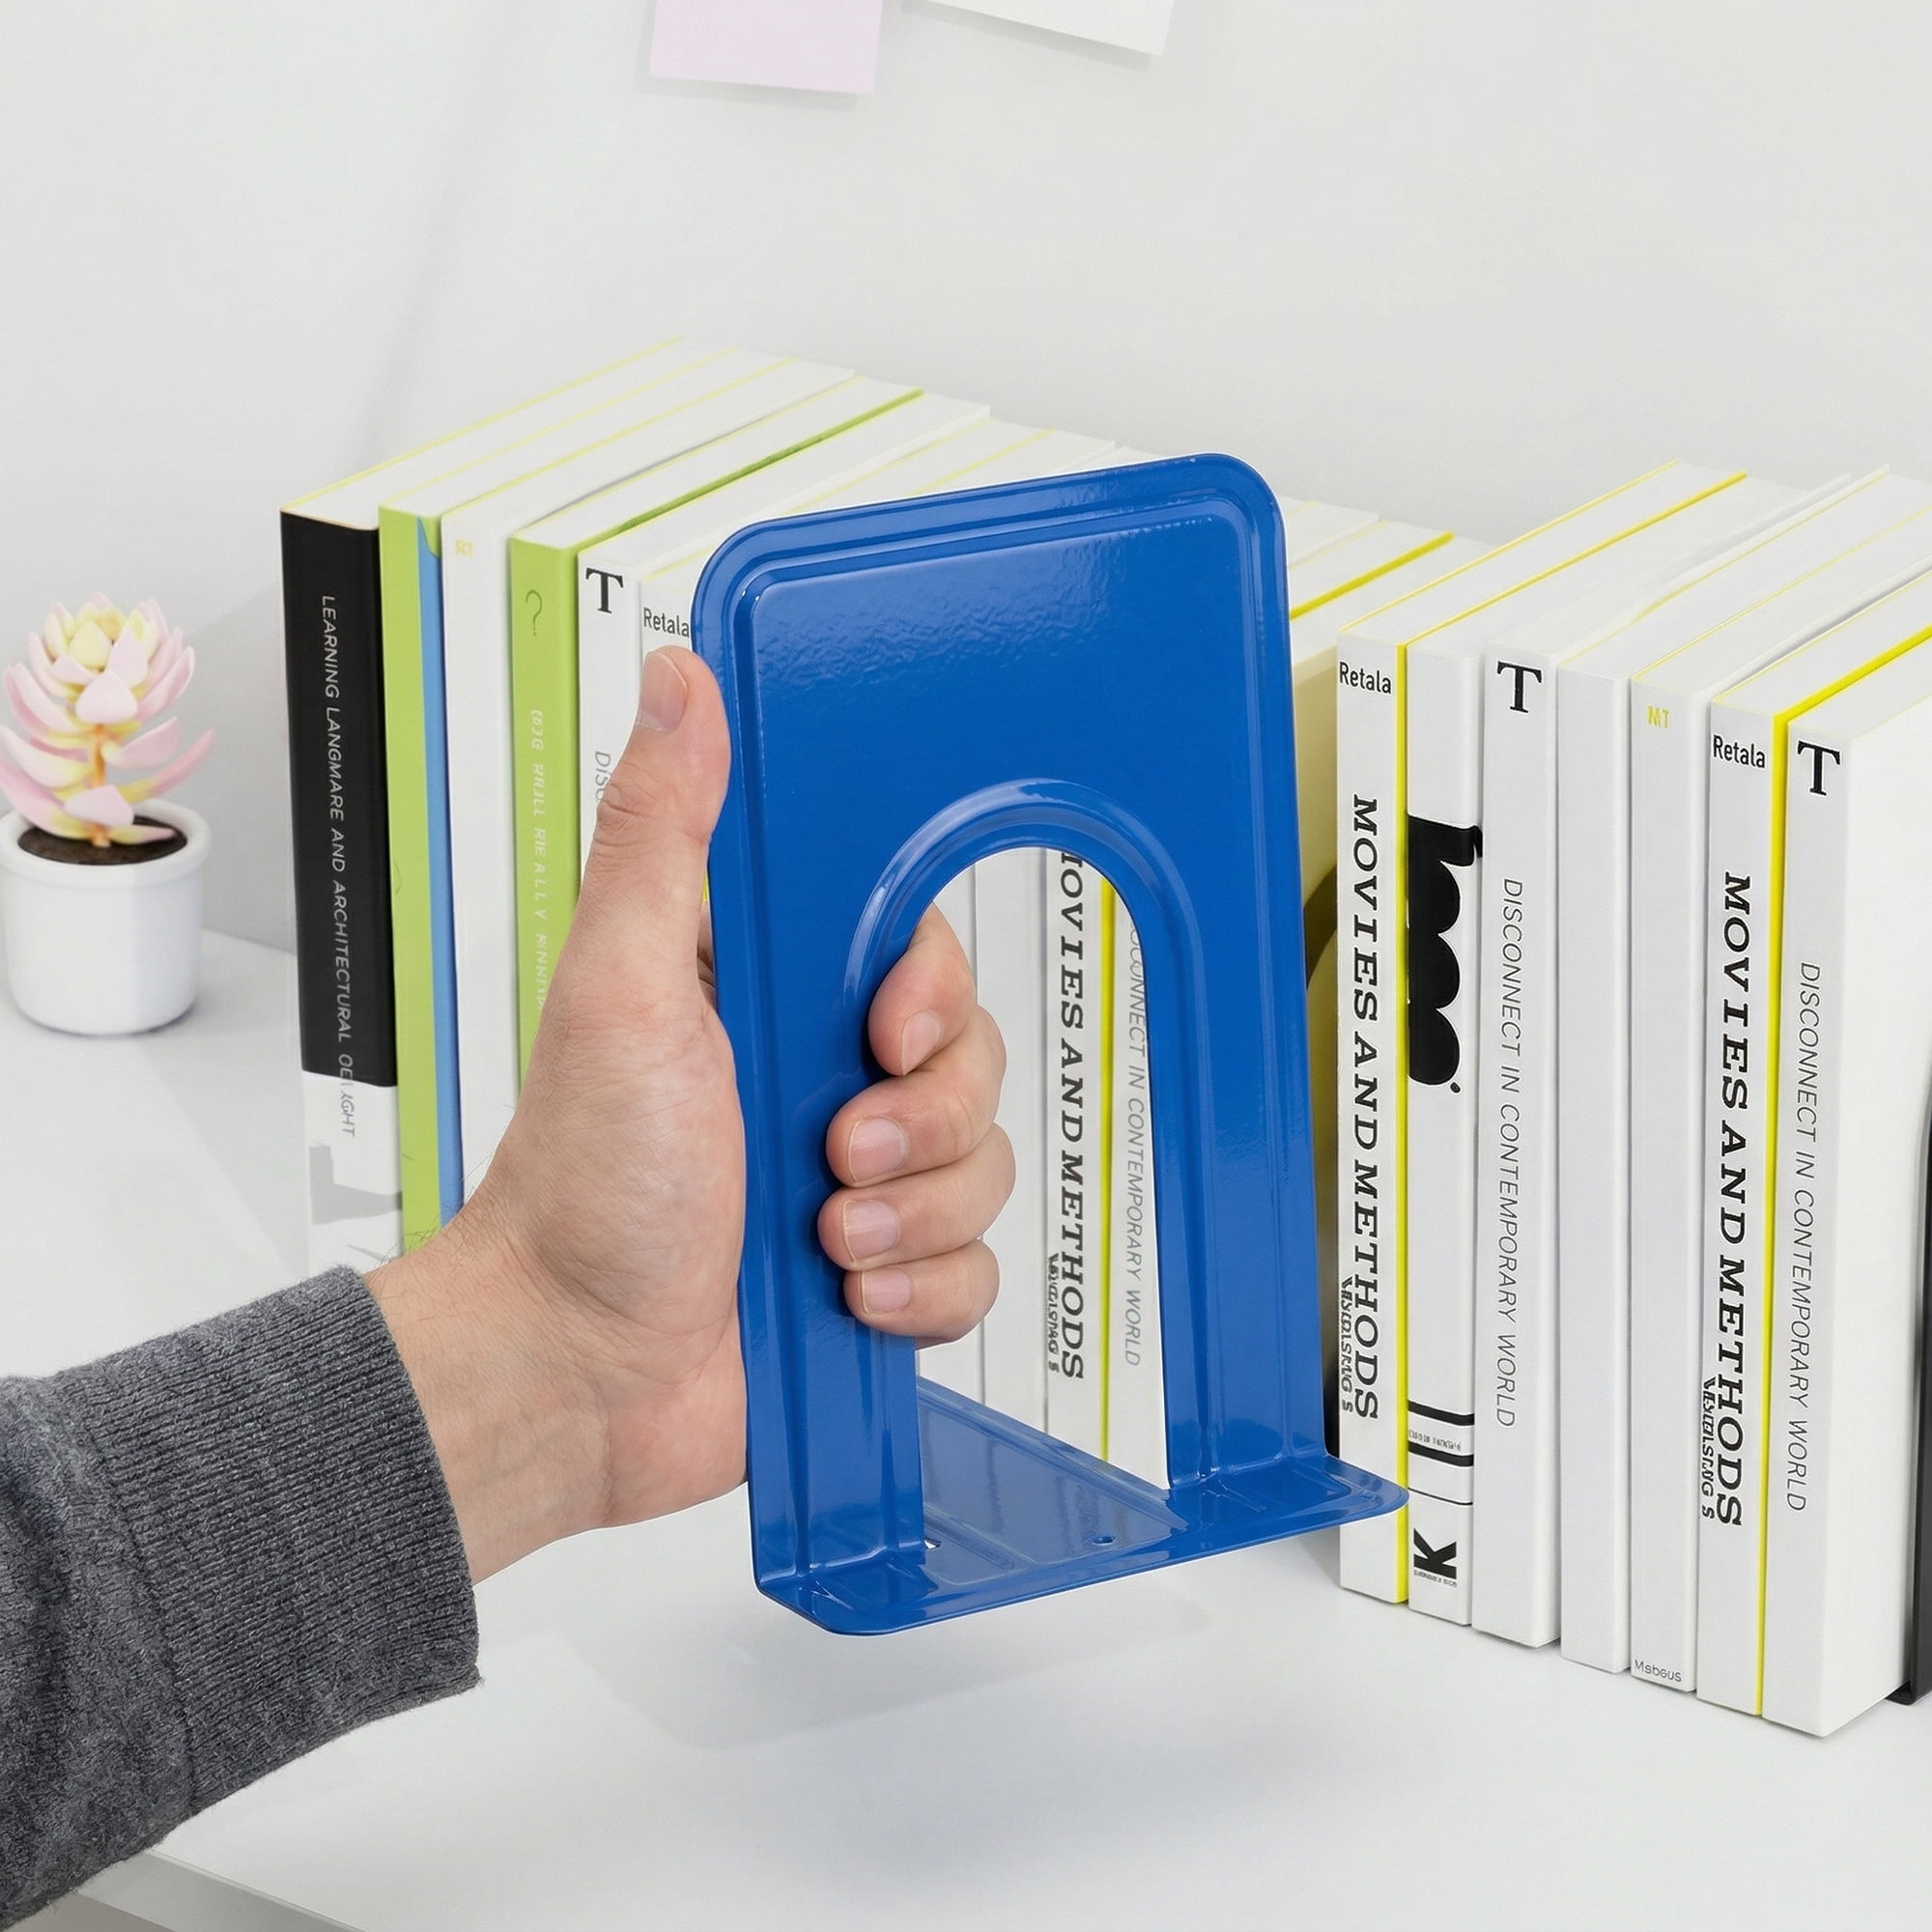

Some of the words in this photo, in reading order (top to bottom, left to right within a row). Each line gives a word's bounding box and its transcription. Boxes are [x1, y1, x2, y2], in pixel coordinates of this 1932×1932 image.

[585, 567, 624, 614] T
[643, 608, 690, 638] Retala
[322, 595, 340, 699] LEARNING
[1339, 662, 1392, 695] Retala
[1496, 661, 1543, 713] T
[1713, 733, 1766, 769] Retala
[1797, 740, 1840, 796] T
[330, 827, 346, 872] AND
[1352, 794, 1378, 1021] MOVIES
[332, 879, 352, 1043] ARCHITECTURAL
[1499, 878, 1523, 1058] DISCONNECT
[1719, 870, 1751, 1110] MOVIES
[1061, 1039, 1084, 1143] AND
[1127, 1065, 1146, 1090] IN
[1352, 1031, 1378, 1150] AND
[1499, 1065, 1521, 1094] IN
[1796, 962, 1821, 1144] DISCONNECT
[1125, 1096, 1146, 1282] CONTEMPORARY
[1496, 1103, 1521, 1323] CONTEMPORARY
[1719, 1120, 1747, 1245] AND
[1794, 1151, 1817, 1179] IN
[1061, 1150, 1084, 1379] METHODS
[1352, 1158, 1378, 1420] METHODS
[1787, 1189, 1815, 1408] CONTEMPORARY
[1124, 1290, 1143, 1366] WORLD
[1495, 1333, 1518, 1427] WORLD
[1717, 1254, 1747, 1526] METHODS
[1786, 1420, 1809, 1512] WORLD
[1413, 1528, 1457, 1580] K
